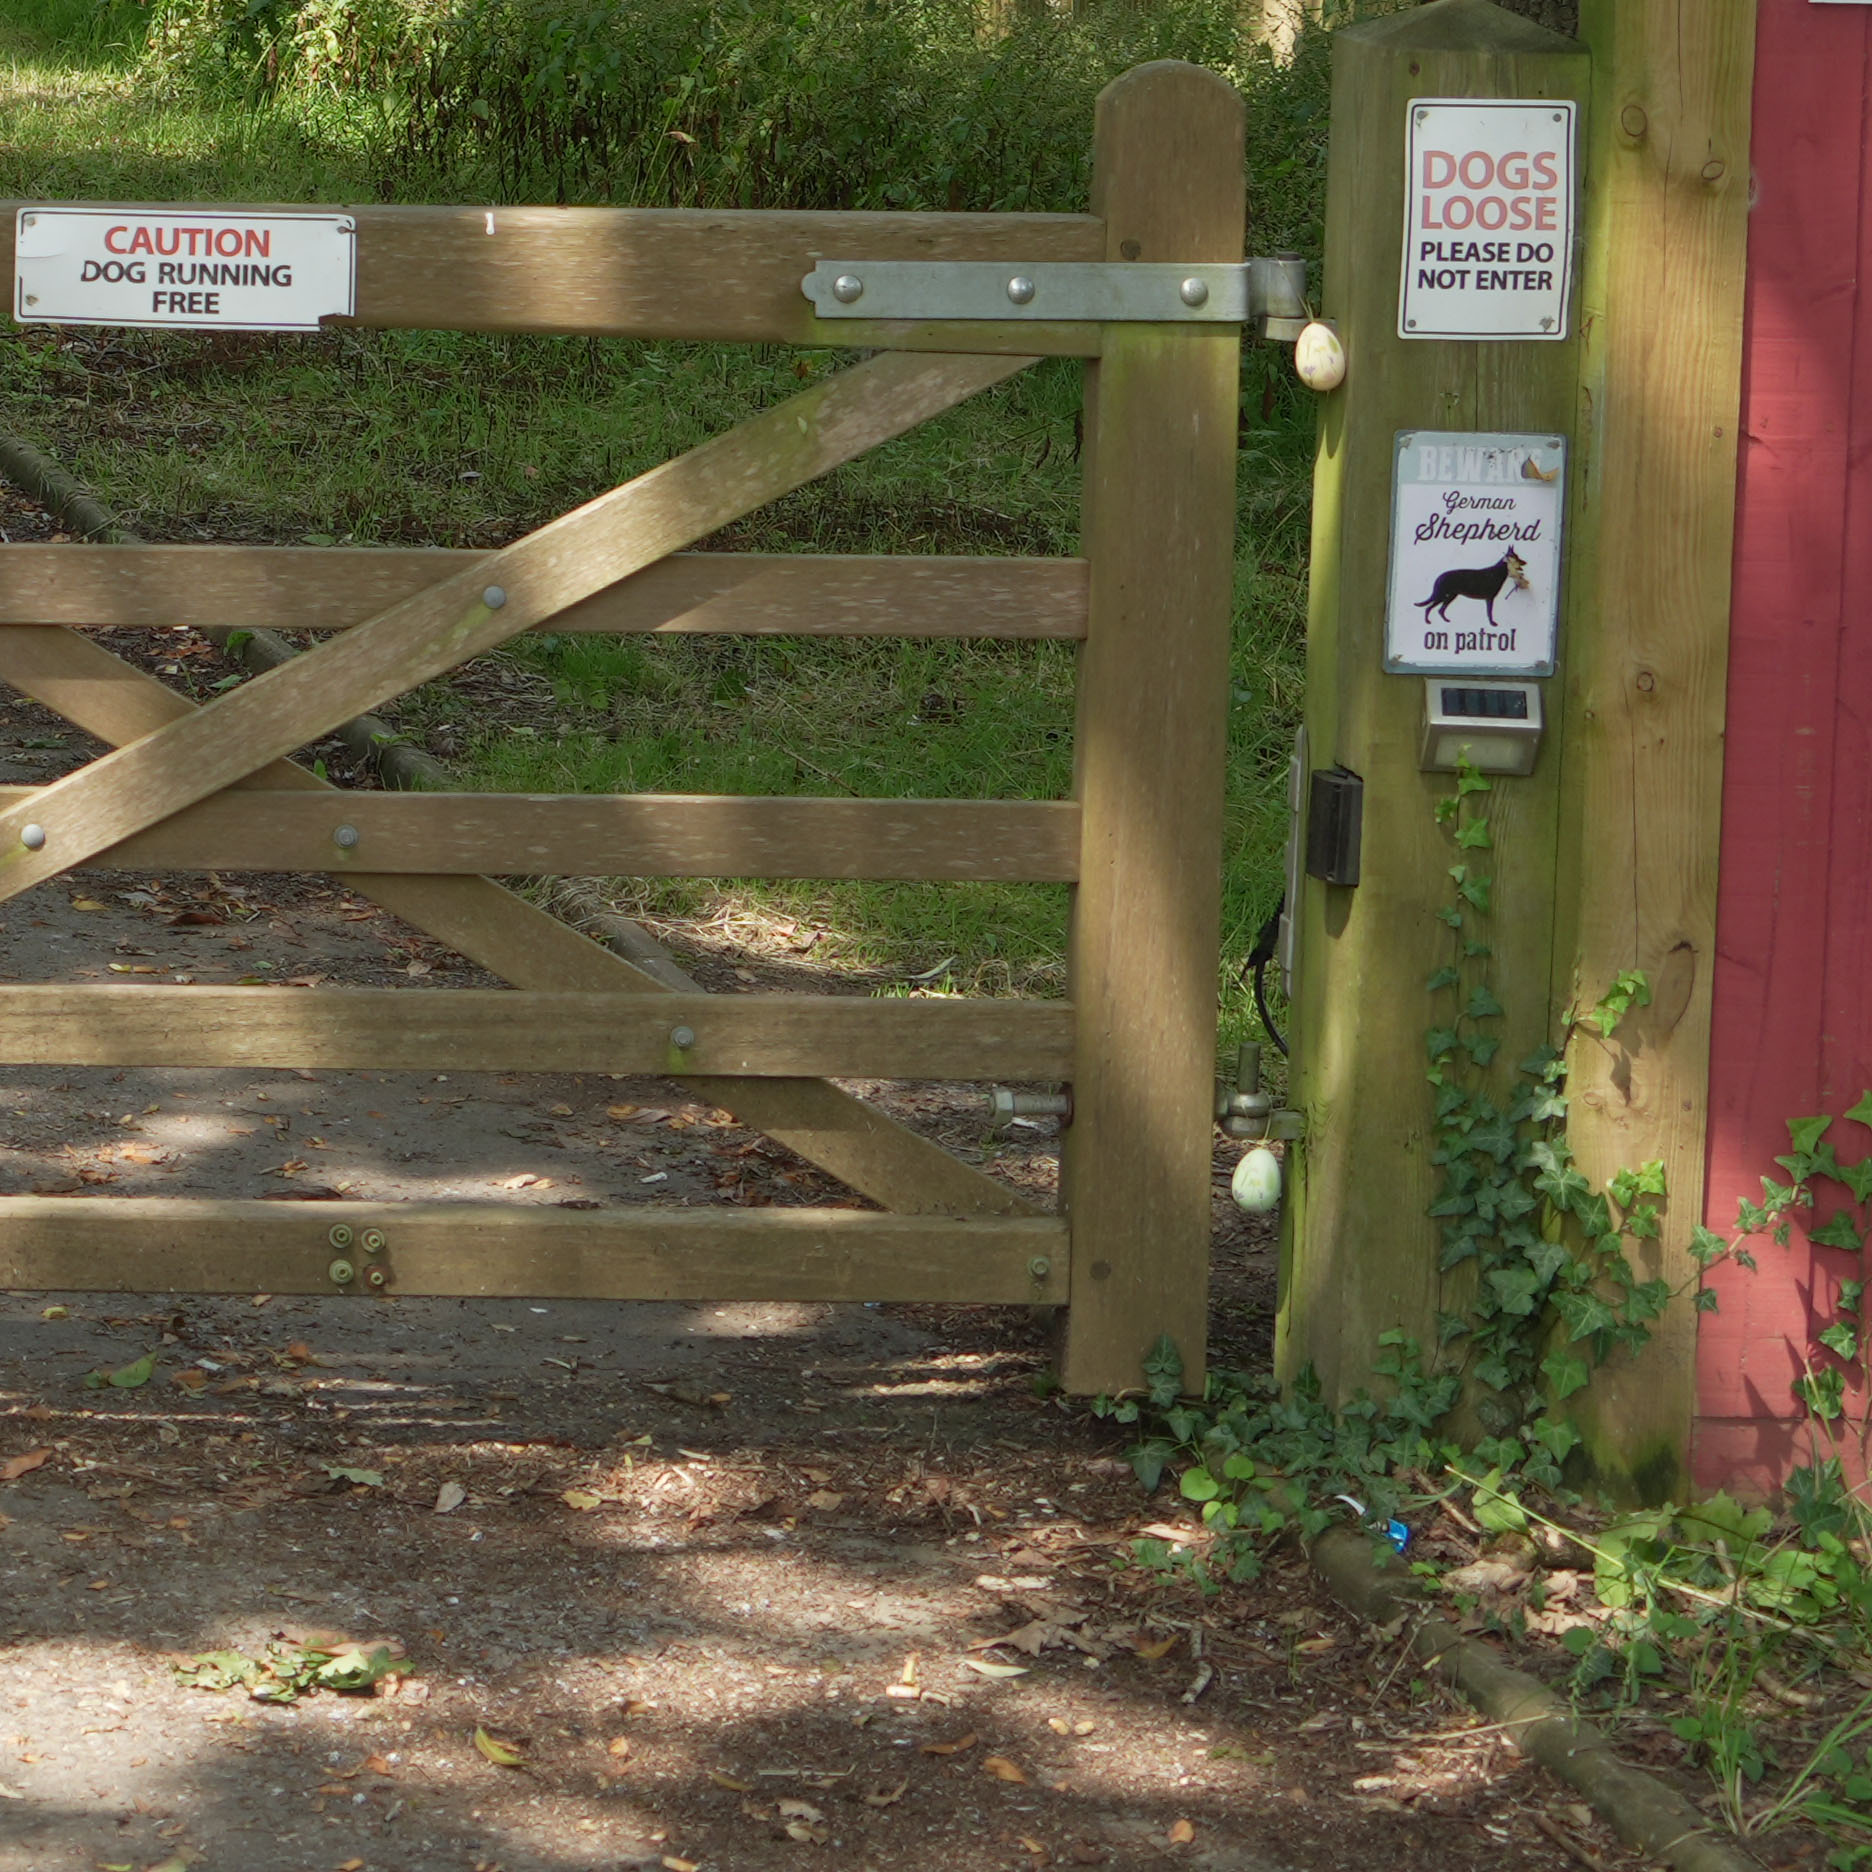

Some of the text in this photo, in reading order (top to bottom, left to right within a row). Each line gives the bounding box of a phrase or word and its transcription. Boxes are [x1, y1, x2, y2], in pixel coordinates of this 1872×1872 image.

[1422, 150, 1558, 190] DOGS
[1421, 195, 1558, 231] LOOSE
[104, 226, 271, 258] CAUTION
[1420, 241, 1554, 263] PLEASE DO
[80, 260, 292, 287] DOG RUNNING
[1417, 269, 1552, 291] NOT ENTER
[152, 291, 220, 314] FREE
[1442, 491, 1517, 515] German
[1414, 513, 1542, 545] Shepherd
[1424, 628, 1517, 655] on patrol
